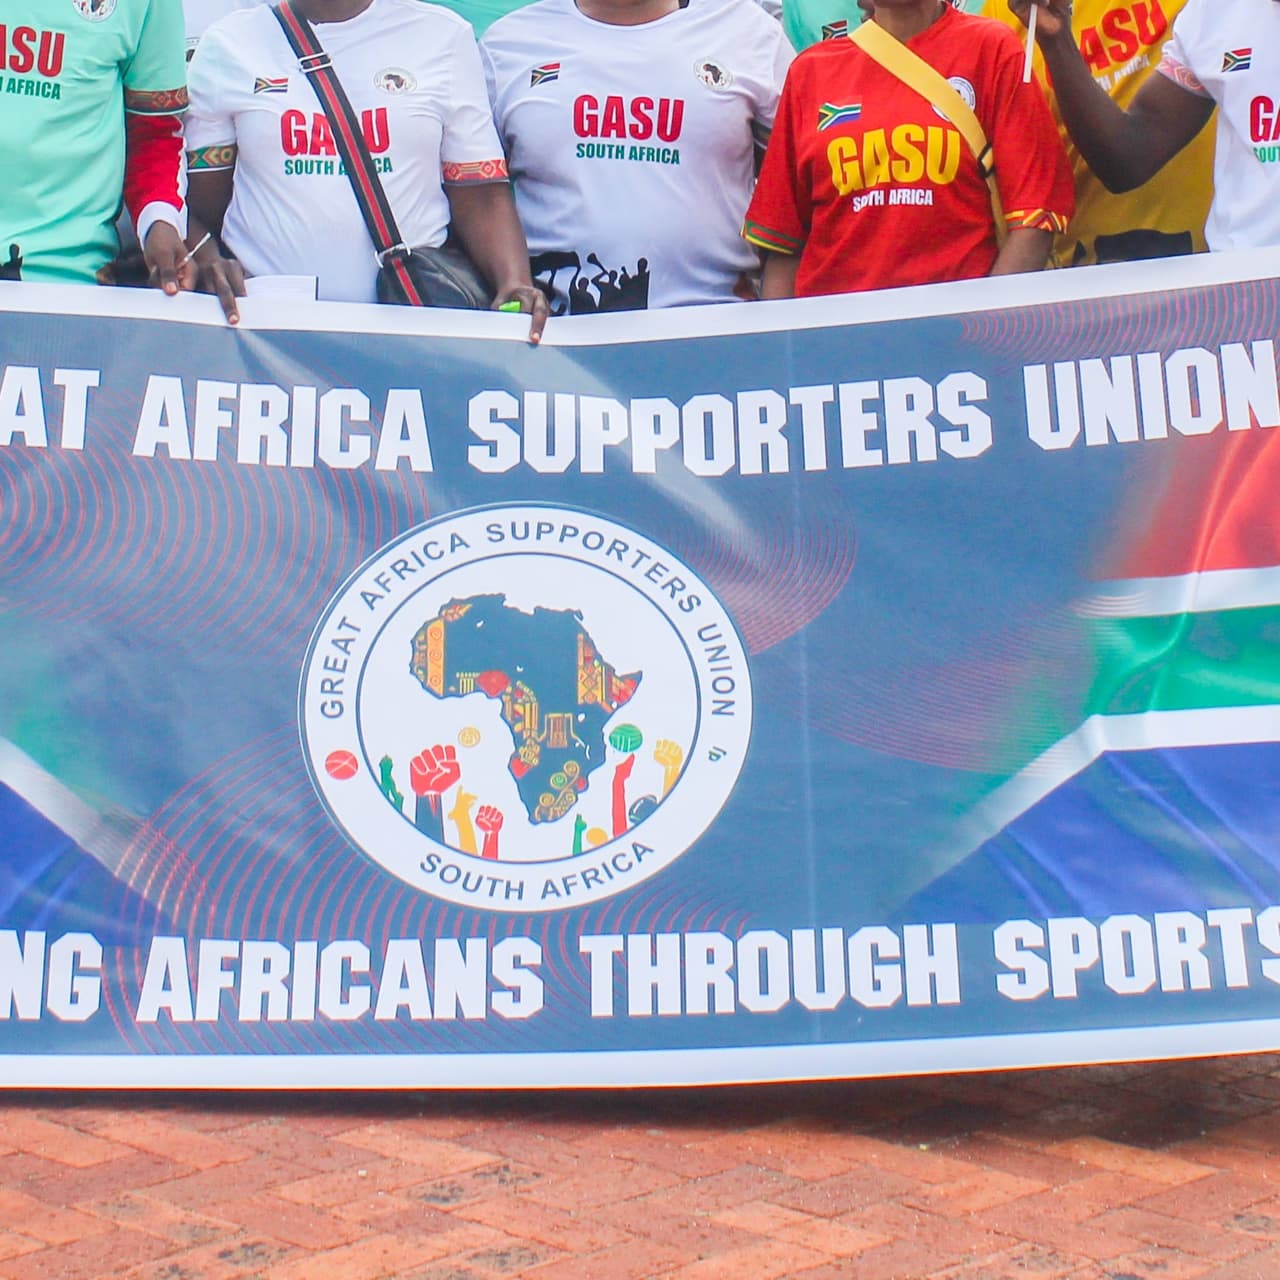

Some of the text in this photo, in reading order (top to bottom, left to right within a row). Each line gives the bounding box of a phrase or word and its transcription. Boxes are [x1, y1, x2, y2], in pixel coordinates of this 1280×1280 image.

[6, 78, 61, 100] AFRICA
[281, 107, 390, 156] GAU
[573, 94, 684, 143] GASU
[284, 157, 392, 175] SOUTH ACA
[576, 143, 680, 165] SOUTH AFRICA
[827, 123, 961, 196] GASU
[888, 188, 933, 205] AFRICA
[132, 375, 433, 473] AFRICA
[467, 370, 993, 477] SUPPORTERS
[1023, 340, 1280, 450] UNION
[320, 521, 735, 720] GREAT AFRICA SUPPORTERS UNION
[420, 840, 654, 901] SOUTH AFRICA
[135, 935, 545, 1022] AFRICANS
[582, 922, 961, 1018] THROUGH
